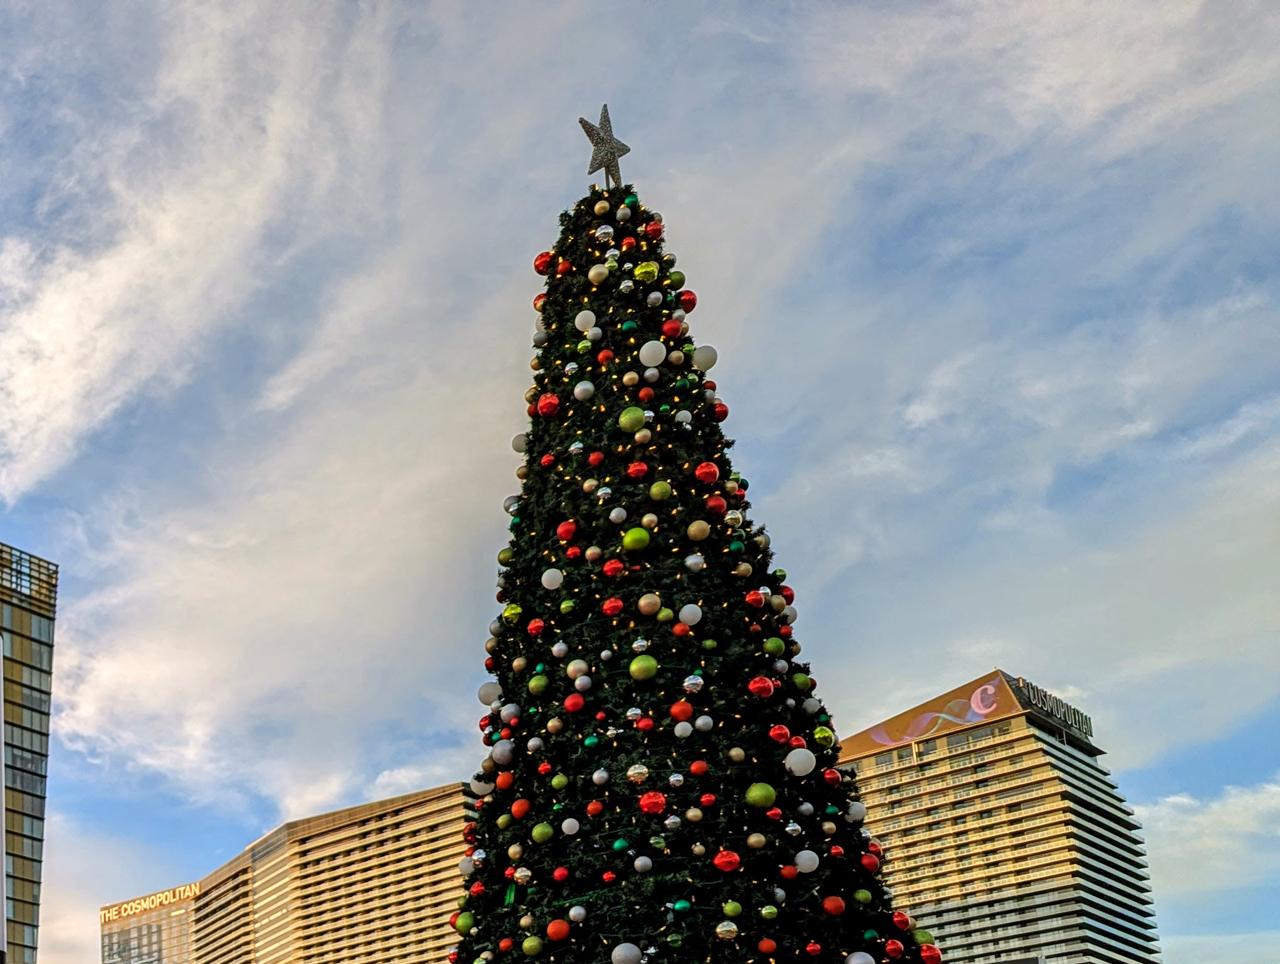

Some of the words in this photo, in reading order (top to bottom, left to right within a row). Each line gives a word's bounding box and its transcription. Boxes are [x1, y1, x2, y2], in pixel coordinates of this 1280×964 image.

[1028, 681, 1094, 738] COSMOPOLITAN
[100, 906, 120, 923] THE
[121, 882, 201, 917] COSMOPOLITAN
